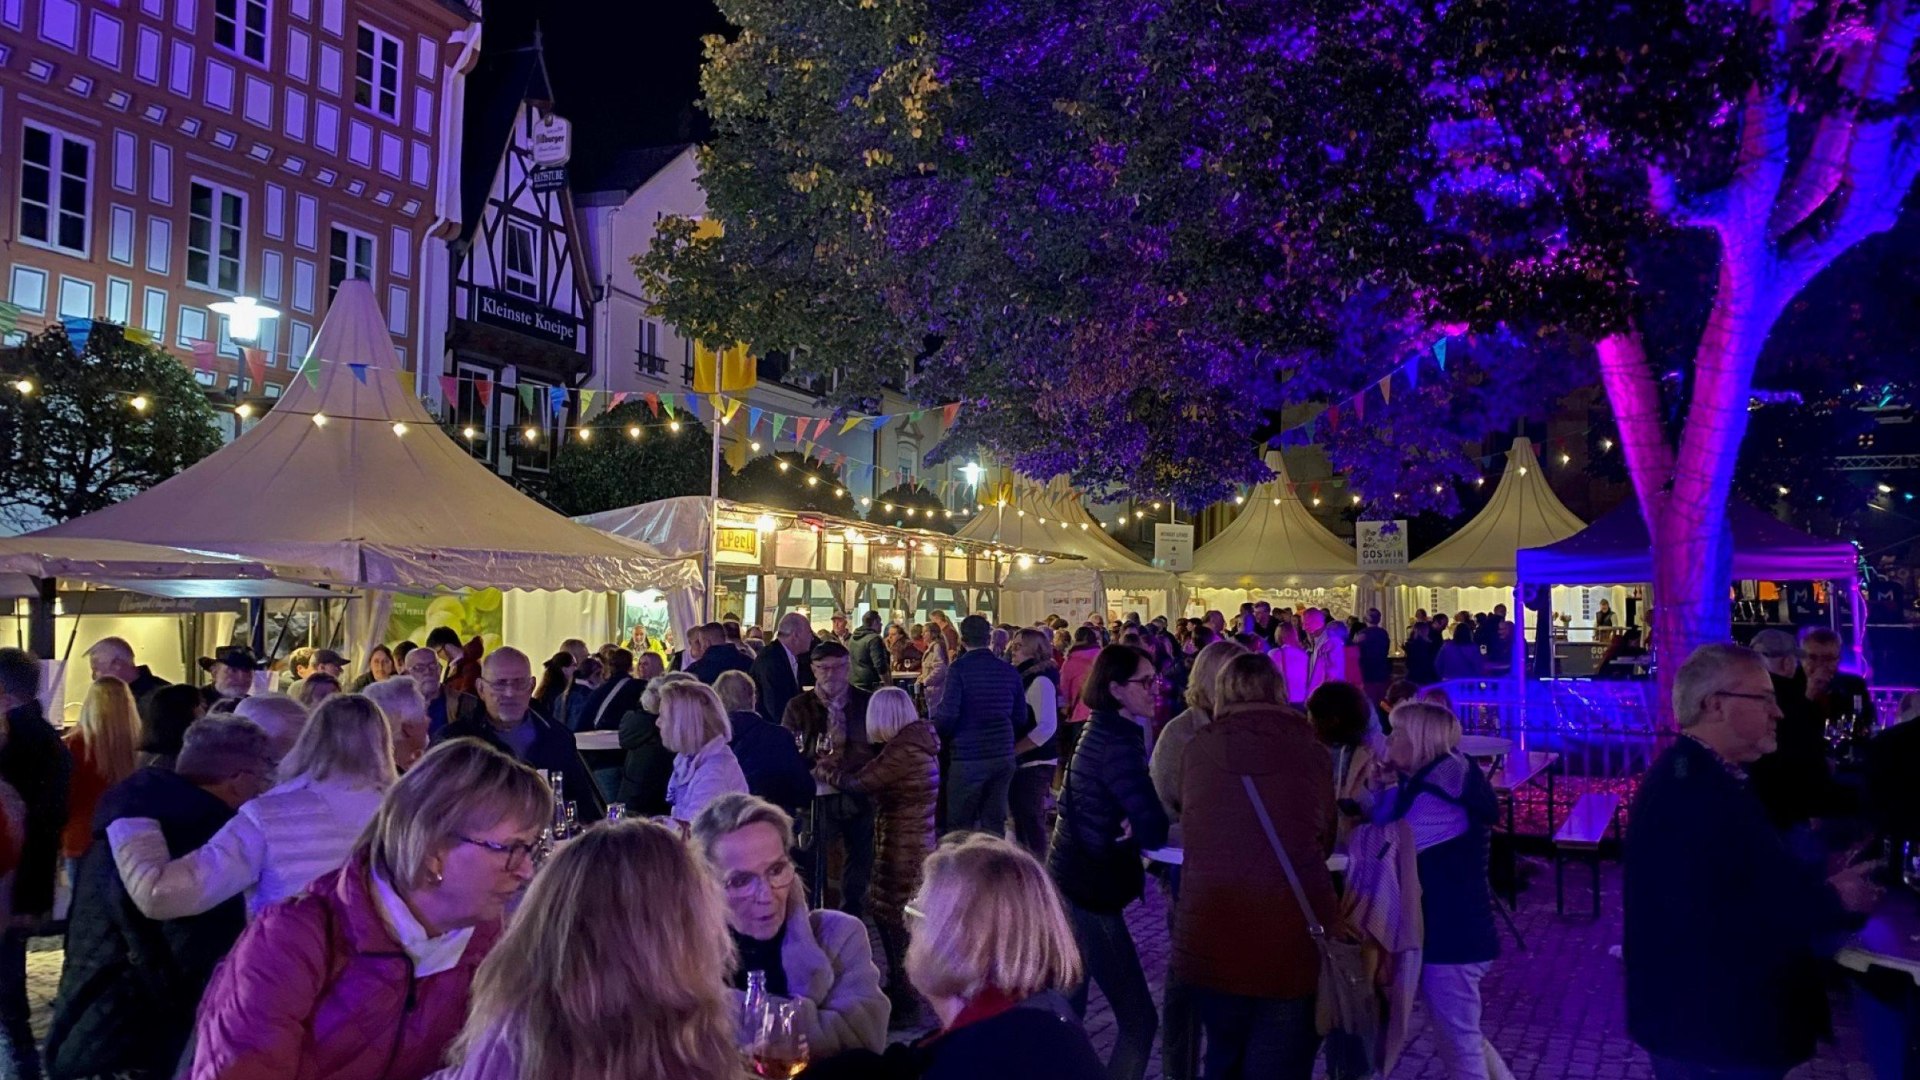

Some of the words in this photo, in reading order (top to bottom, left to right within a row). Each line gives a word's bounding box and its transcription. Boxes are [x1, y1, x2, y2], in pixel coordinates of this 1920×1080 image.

[482, 296, 532, 325] Kleinste
[535, 312, 574, 340] Kneipe
[1363, 550, 1404, 558] GOSWIN
